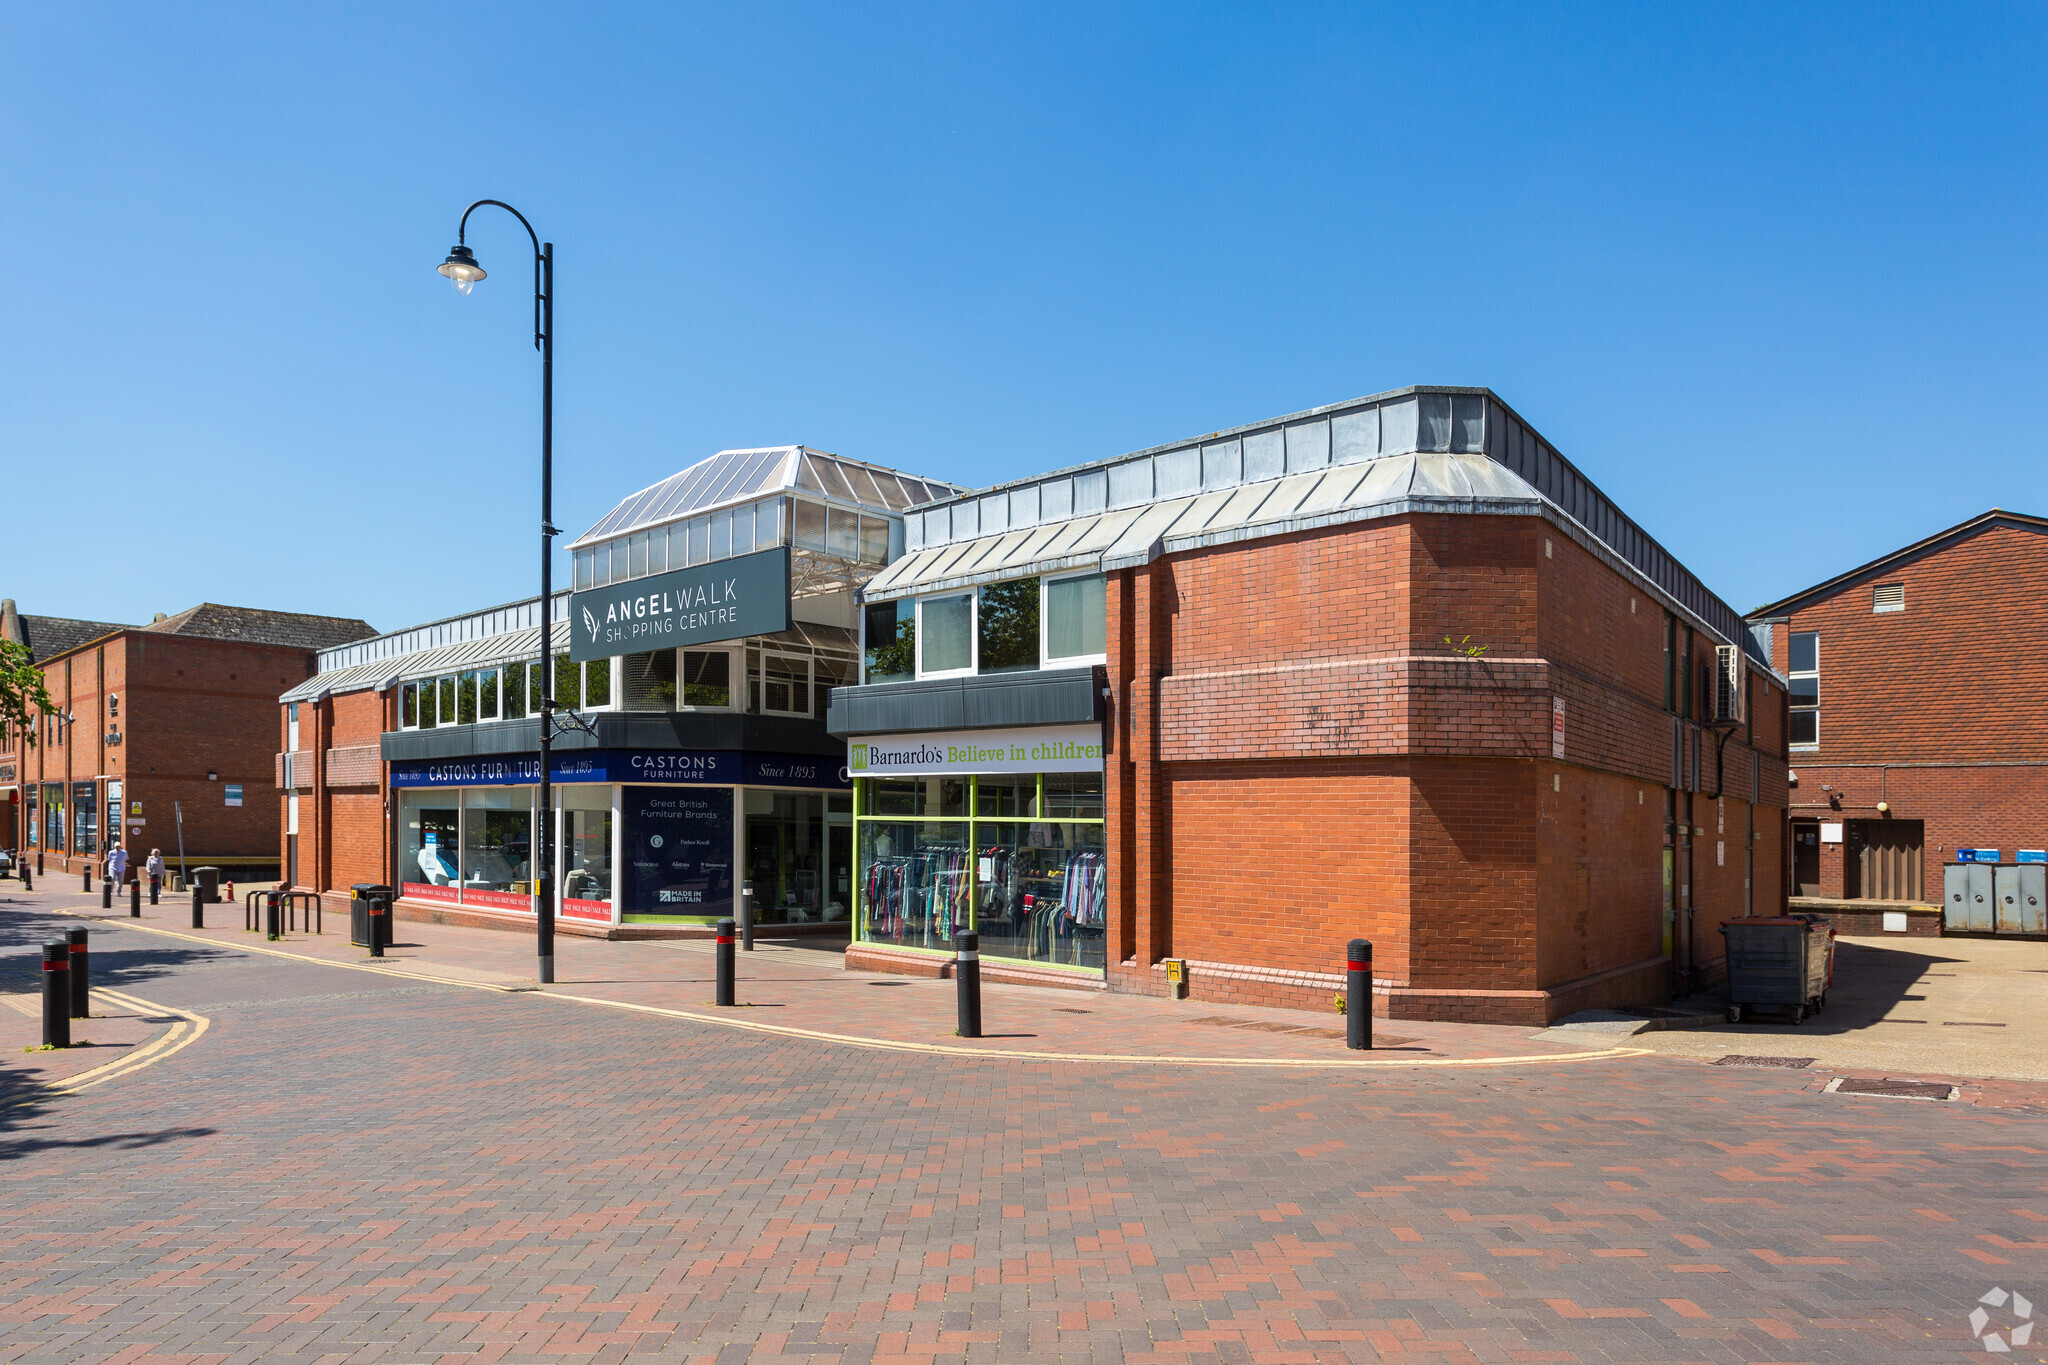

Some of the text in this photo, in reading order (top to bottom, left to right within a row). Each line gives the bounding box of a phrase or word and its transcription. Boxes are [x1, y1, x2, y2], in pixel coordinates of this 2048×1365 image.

[680, 606, 736, 630] CENTRE
[870, 744, 943, 766] Barnardo's
[947, 745, 1005, 763] Believe
[1009, 743, 1027, 760] in
[560, 760, 593, 774] Since 1895
[631, 755, 716, 769] CASTONS
[429, 761, 541, 781] CASTONS FURNITUR
[643, 770, 705, 779] FURNITURE
[759, 763, 816, 779] Since 1895
[650, 800, 708, 808] Great British
[641, 809, 718, 819] Furniture Brands
[563, 903, 611, 915] SALE SALE SALE SALE SALE
[1168, 963, 1180, 979] H
